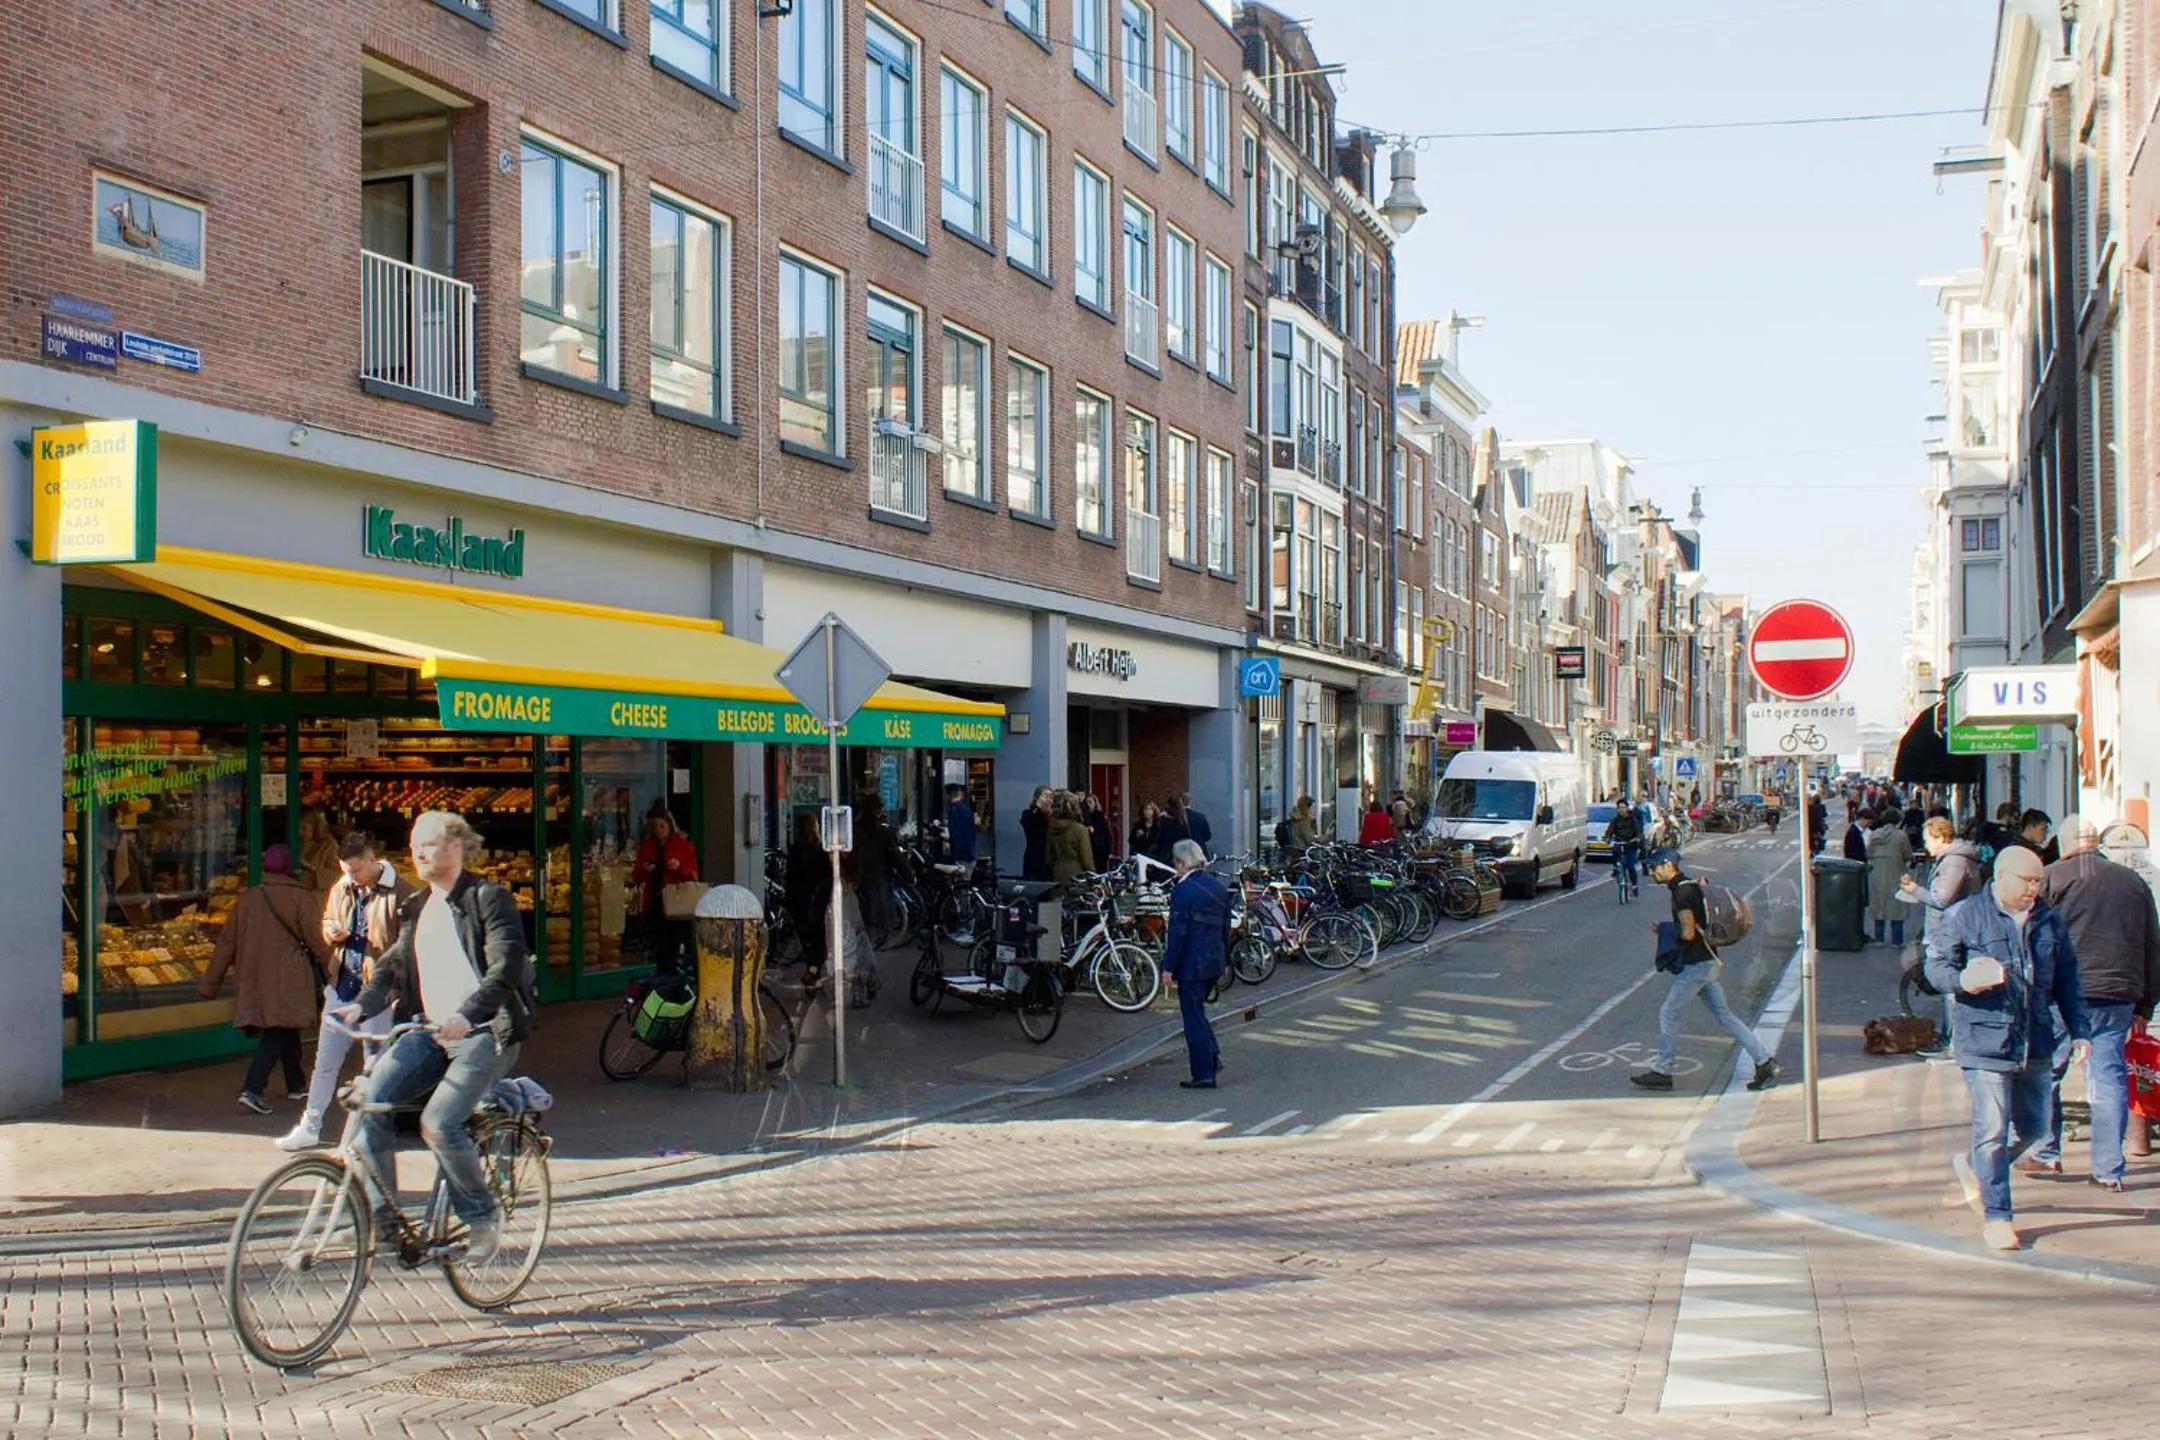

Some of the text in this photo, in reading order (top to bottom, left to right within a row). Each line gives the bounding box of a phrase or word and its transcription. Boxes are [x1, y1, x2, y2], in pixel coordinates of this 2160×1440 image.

[48, 320, 115, 350] HAARLEMMER
[41, 432, 127, 460] Kaasland
[45, 475, 122, 495] CROISSANTS
[62, 497, 104, 510] NOTEN
[66, 516, 99, 529] KAAS
[60, 533, 105, 547] BROOD
[364, 503, 525, 578] Kaasland
[1074, 642, 1109, 673] Albert
[1993, 680, 2047, 705] VIS
[453, 691, 551, 722] FROMAGE
[610, 702, 667, 728] CHEESE
[1751, 705, 1855, 720] uitgezonderd
[718, 709, 775, 733] BELEGDE
[885, 714, 911, 739] KÄSE
